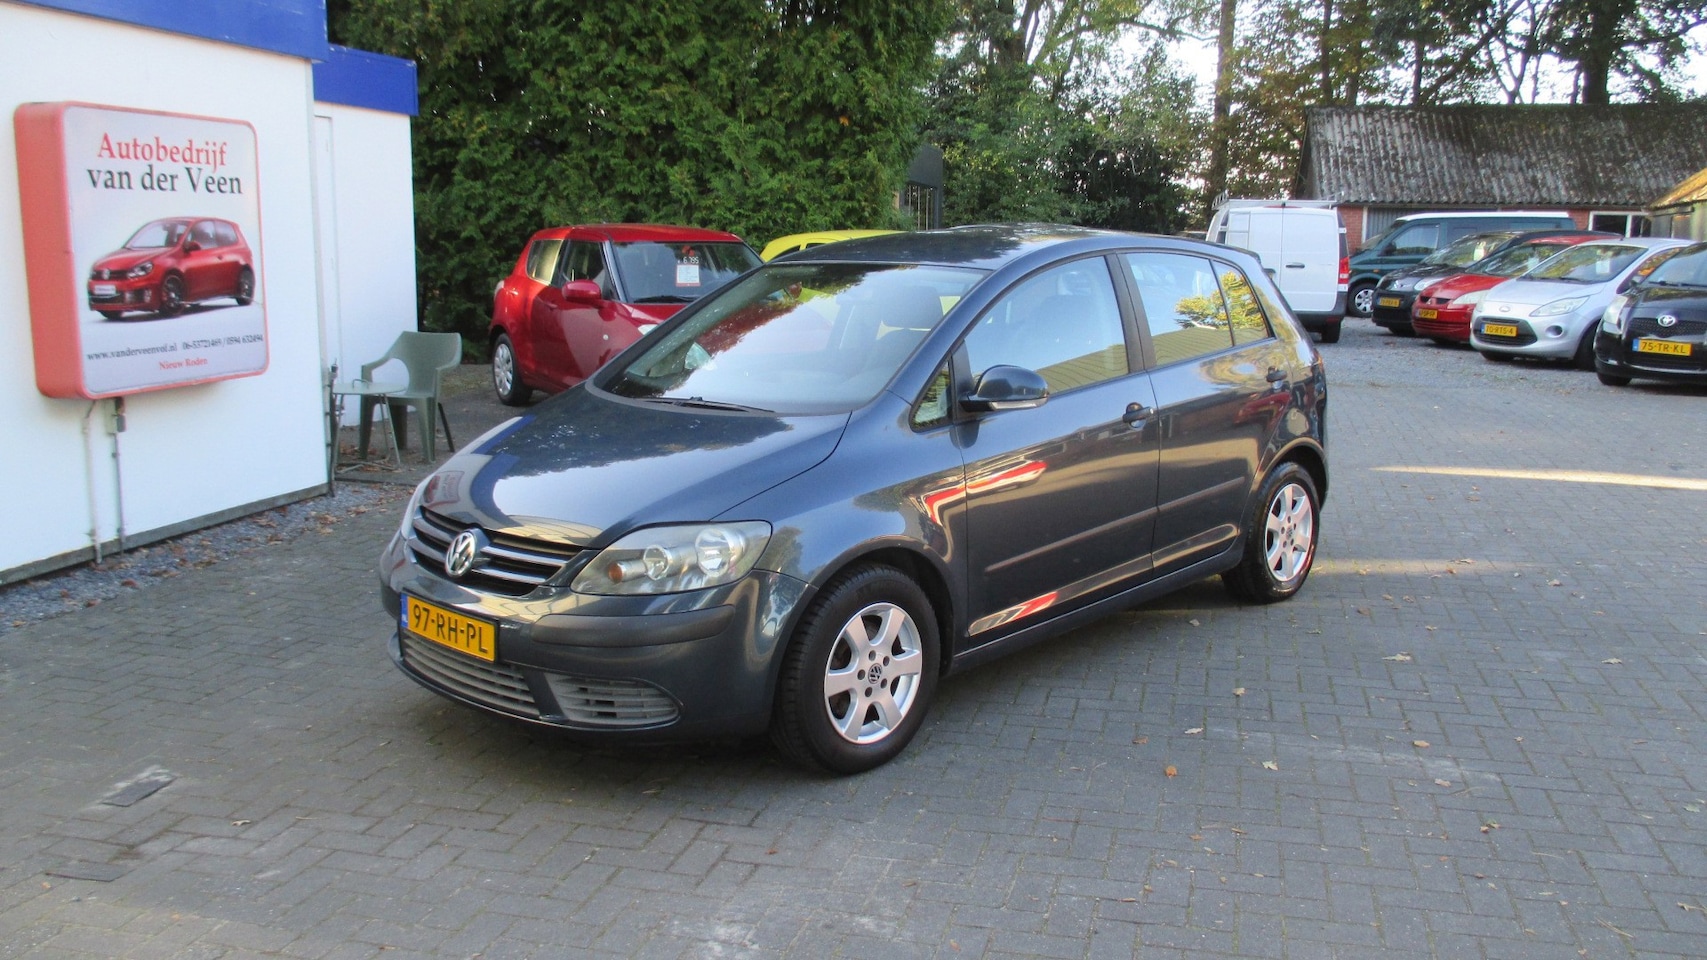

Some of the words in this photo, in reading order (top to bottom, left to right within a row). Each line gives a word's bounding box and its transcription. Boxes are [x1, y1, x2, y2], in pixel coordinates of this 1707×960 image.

[97, 132, 227, 174] Autobedrijf
[87, 169, 134, 190] van
[140, 164, 179, 192] der
[186, 166, 243, 194] Veen
[1641, 341, 1686, 354] 75-TR-KL
[159, 358, 184, 371] Nieuw
[185, 357, 208, 368] Roden
[413, 604, 488, 654] 97-RH-PL
